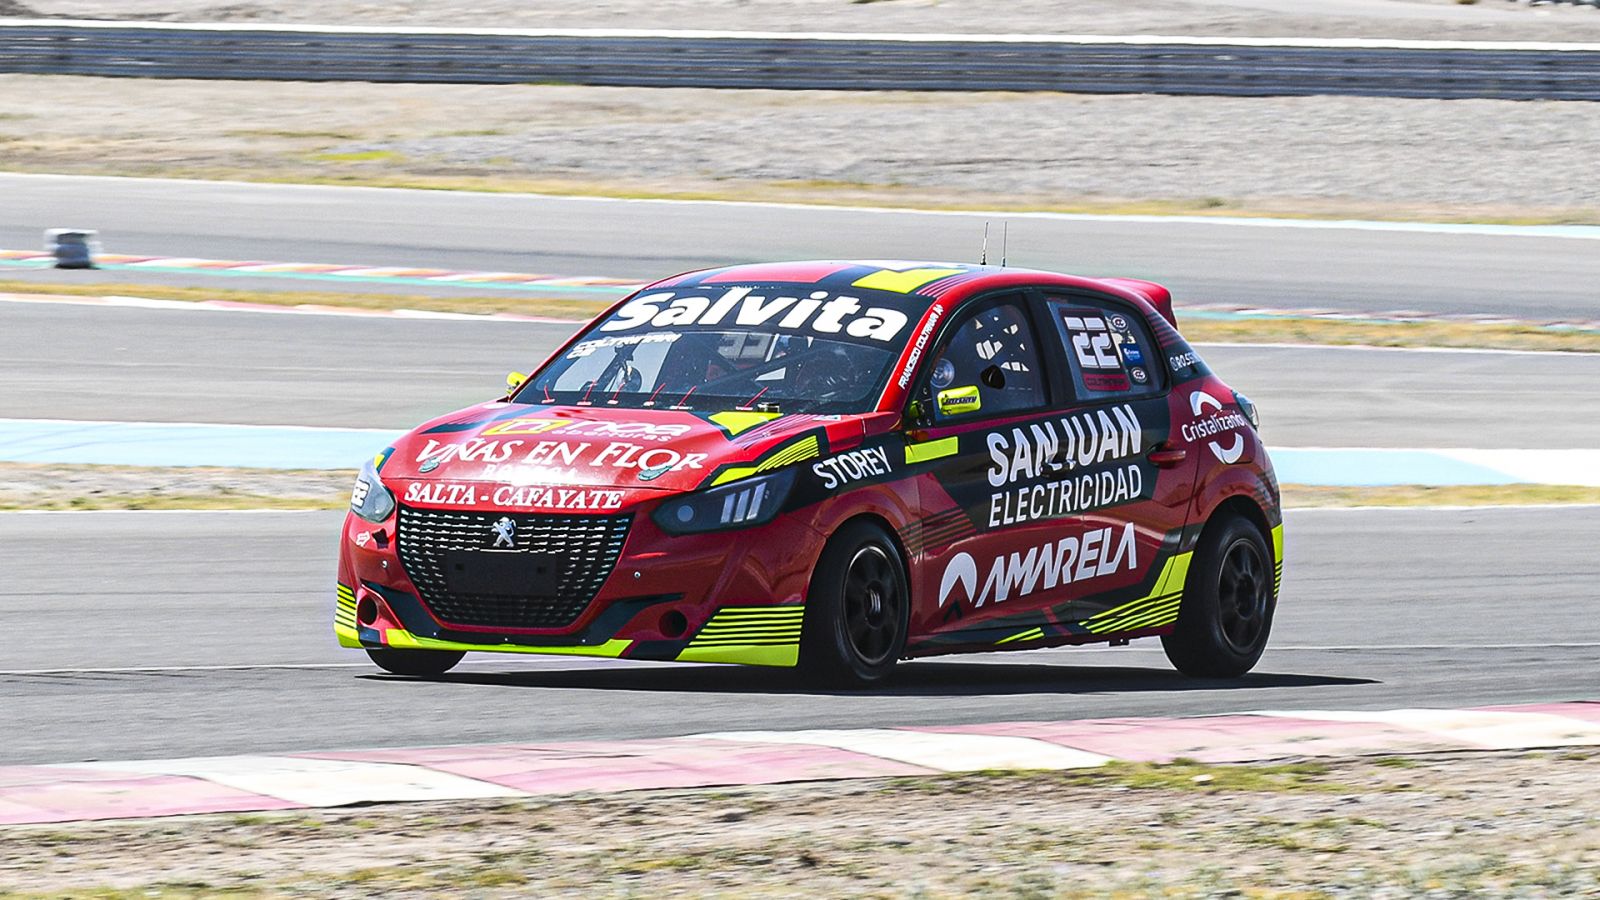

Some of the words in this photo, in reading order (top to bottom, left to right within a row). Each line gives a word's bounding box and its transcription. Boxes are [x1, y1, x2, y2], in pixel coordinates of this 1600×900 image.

[599, 288, 908, 342] Salvita
[1063, 316, 1121, 369] 22
[415, 437, 524, 463] VIÑAS
[521, 441, 592, 467] EN
[589, 441, 709, 472] FLOR
[812, 446, 892, 489] STOREY
[986, 421, 1062, 487] SAN
[1061, 404, 1142, 470] JUAN
[404, 482, 476, 505] SALTA
[493, 486, 625, 509] CAFAYATE
[989, 464, 1142, 527] ELECTRICIDAD
[975, 522, 1137, 608] AMARELA
